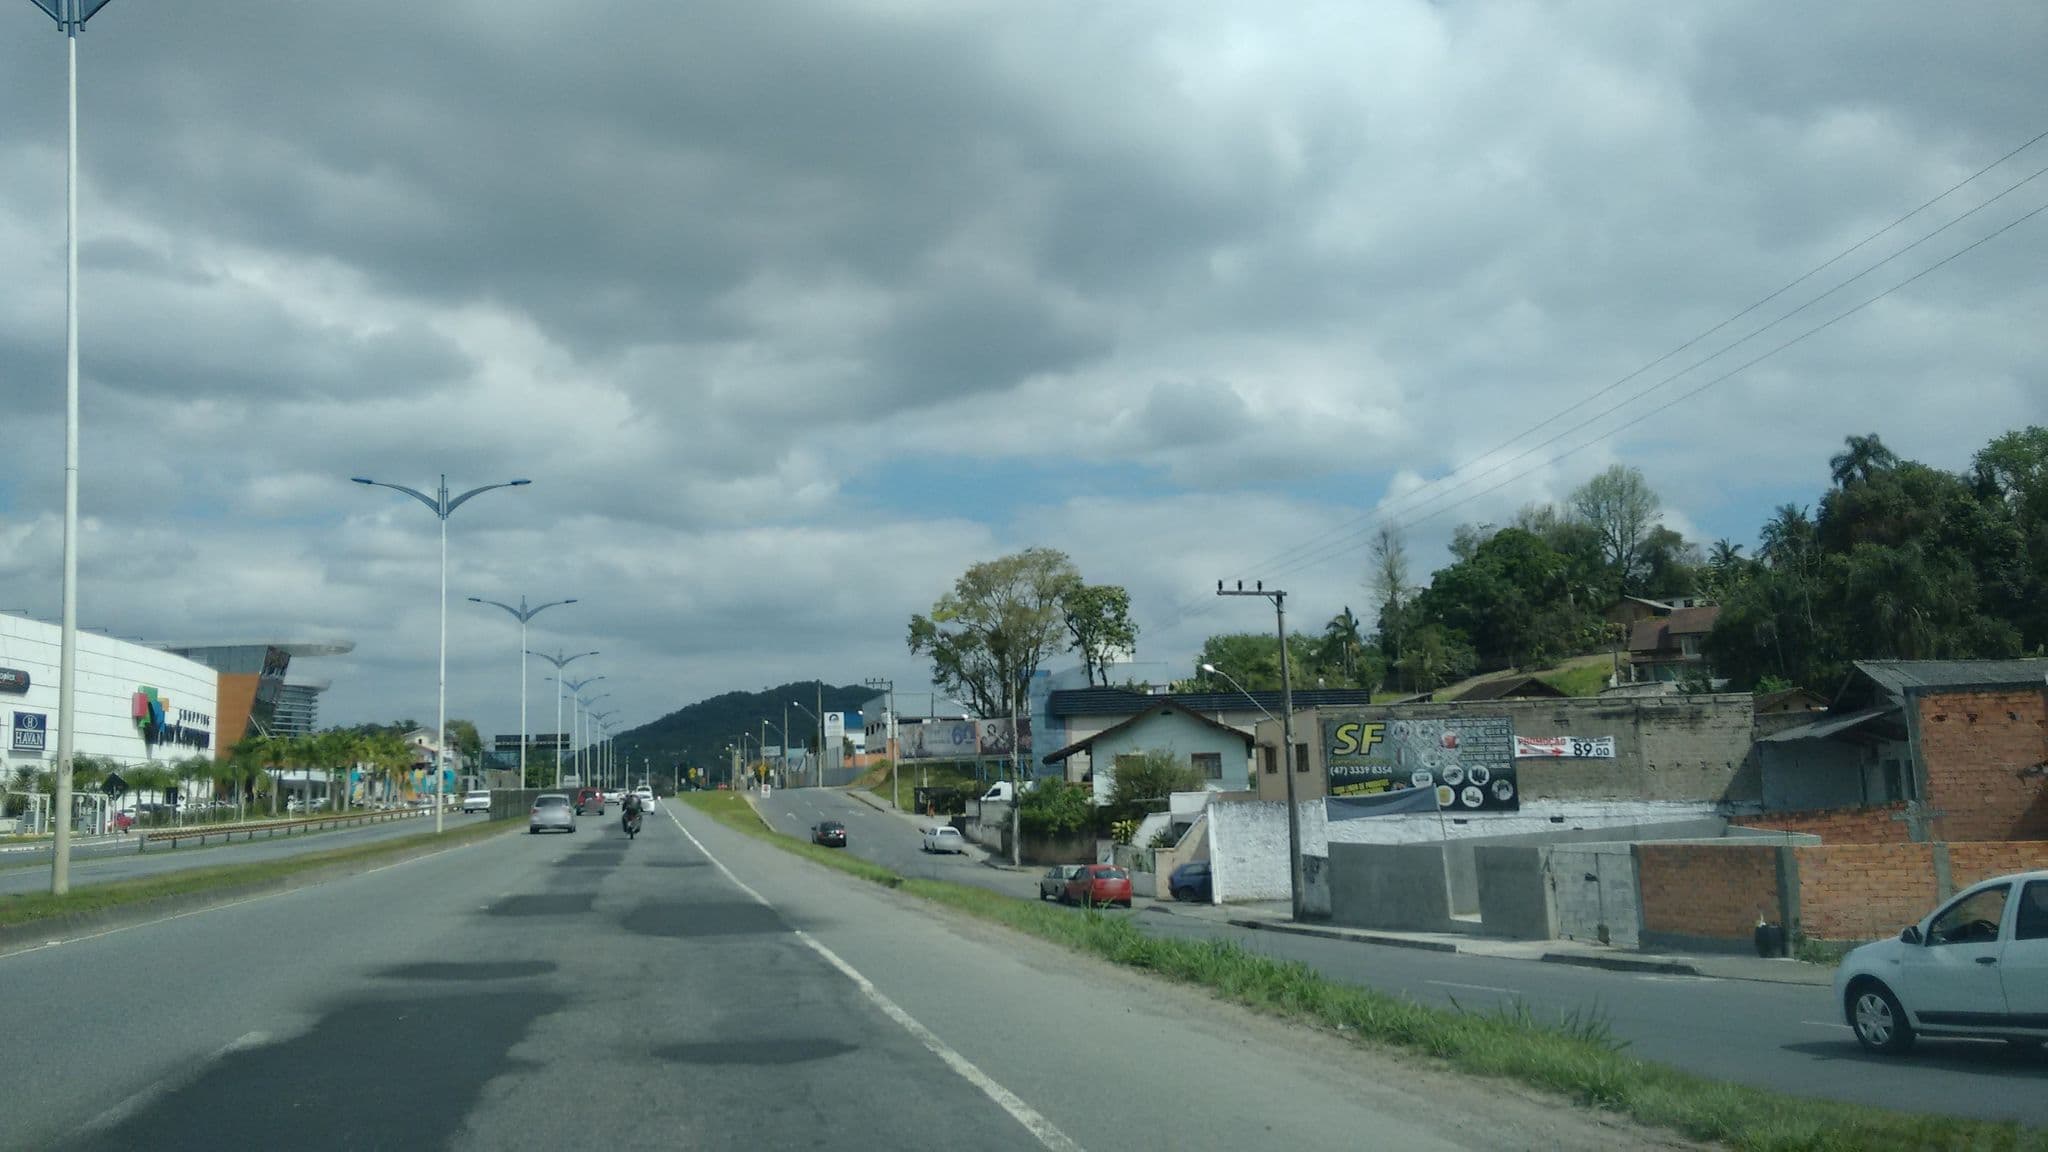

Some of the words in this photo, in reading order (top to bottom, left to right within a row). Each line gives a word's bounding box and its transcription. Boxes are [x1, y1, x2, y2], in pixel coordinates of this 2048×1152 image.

[15, 731, 43, 745] HAVAN
[1332, 723, 1386, 756] SF
[1330, 766, 1348, 777] (47)
